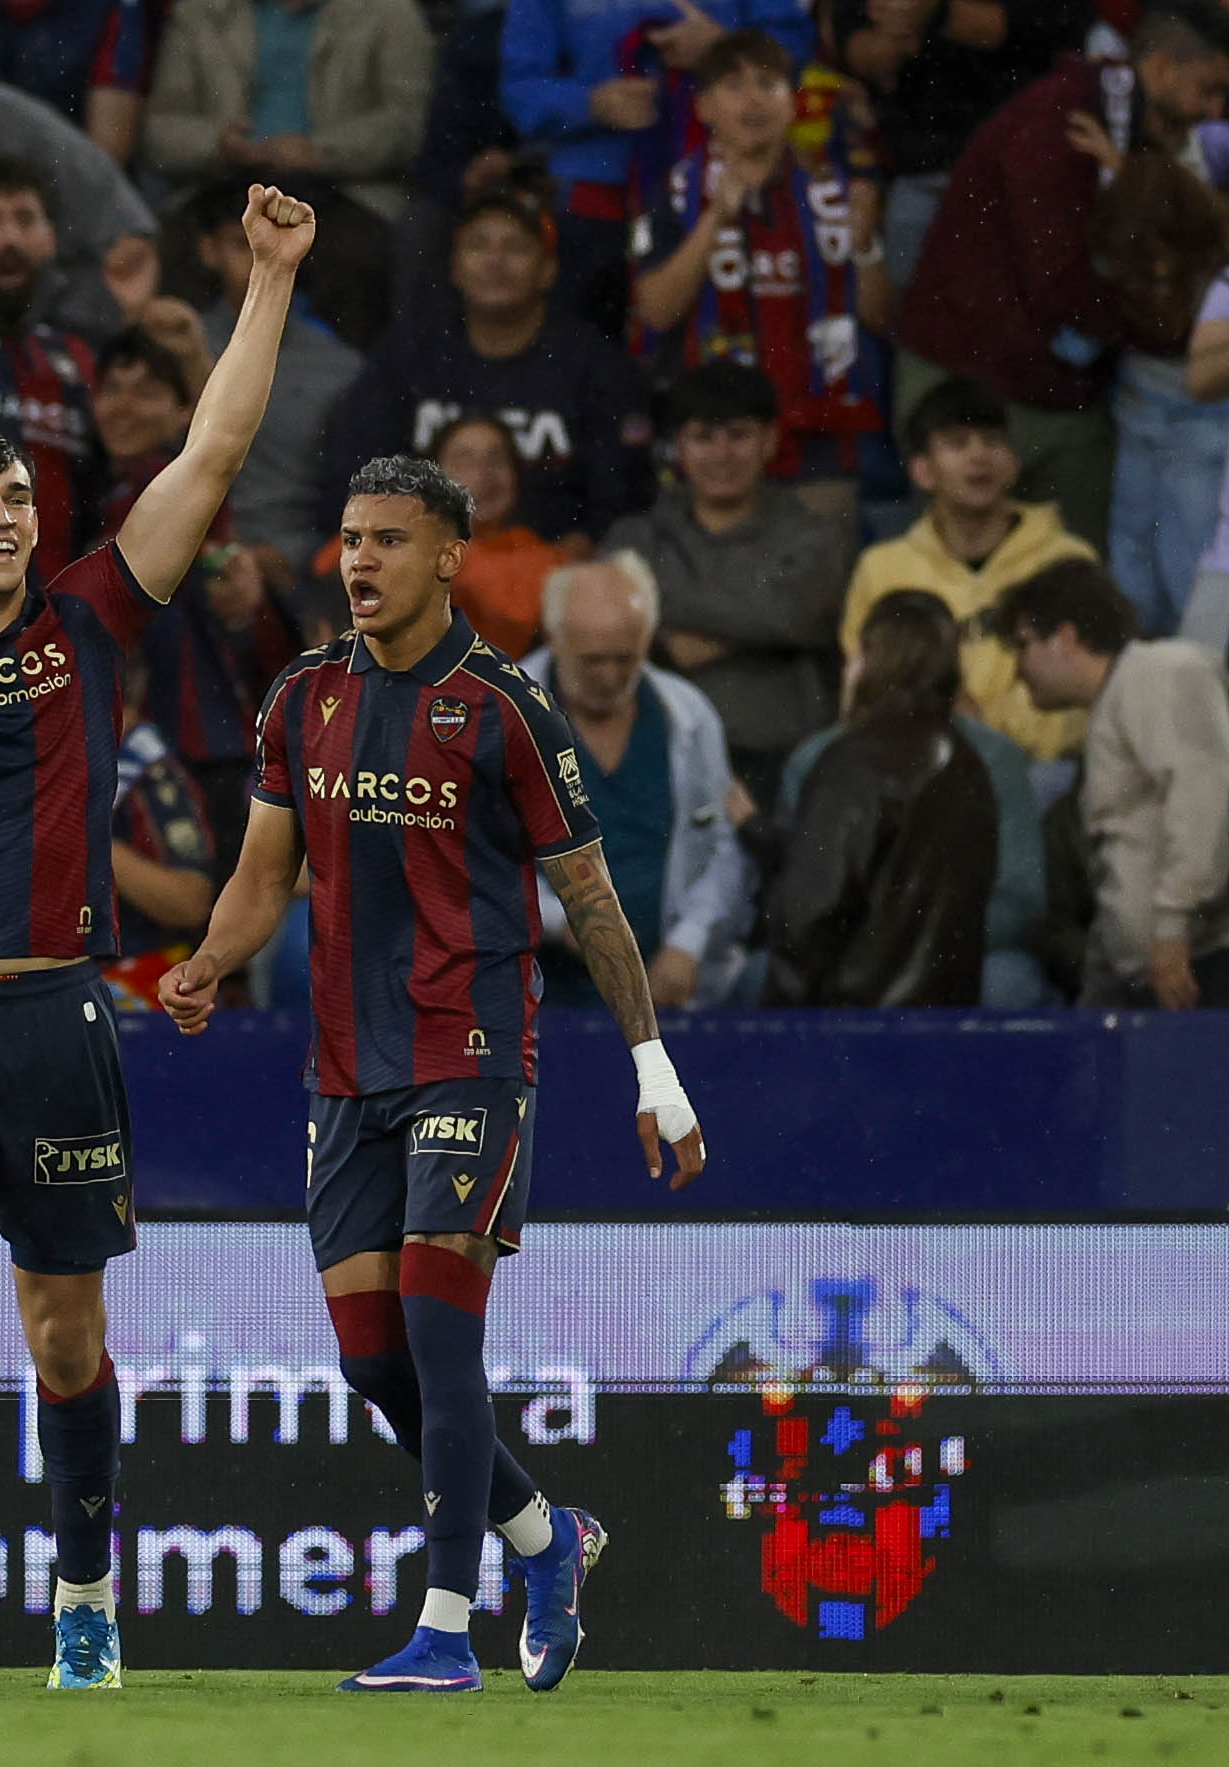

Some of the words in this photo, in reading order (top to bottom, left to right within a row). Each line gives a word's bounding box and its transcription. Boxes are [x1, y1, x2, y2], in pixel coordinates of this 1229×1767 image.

[308, 767, 458, 809] MARCOS
[419, 1115, 478, 1143] JYSK
[57, 1142, 121, 1173] JYSK
